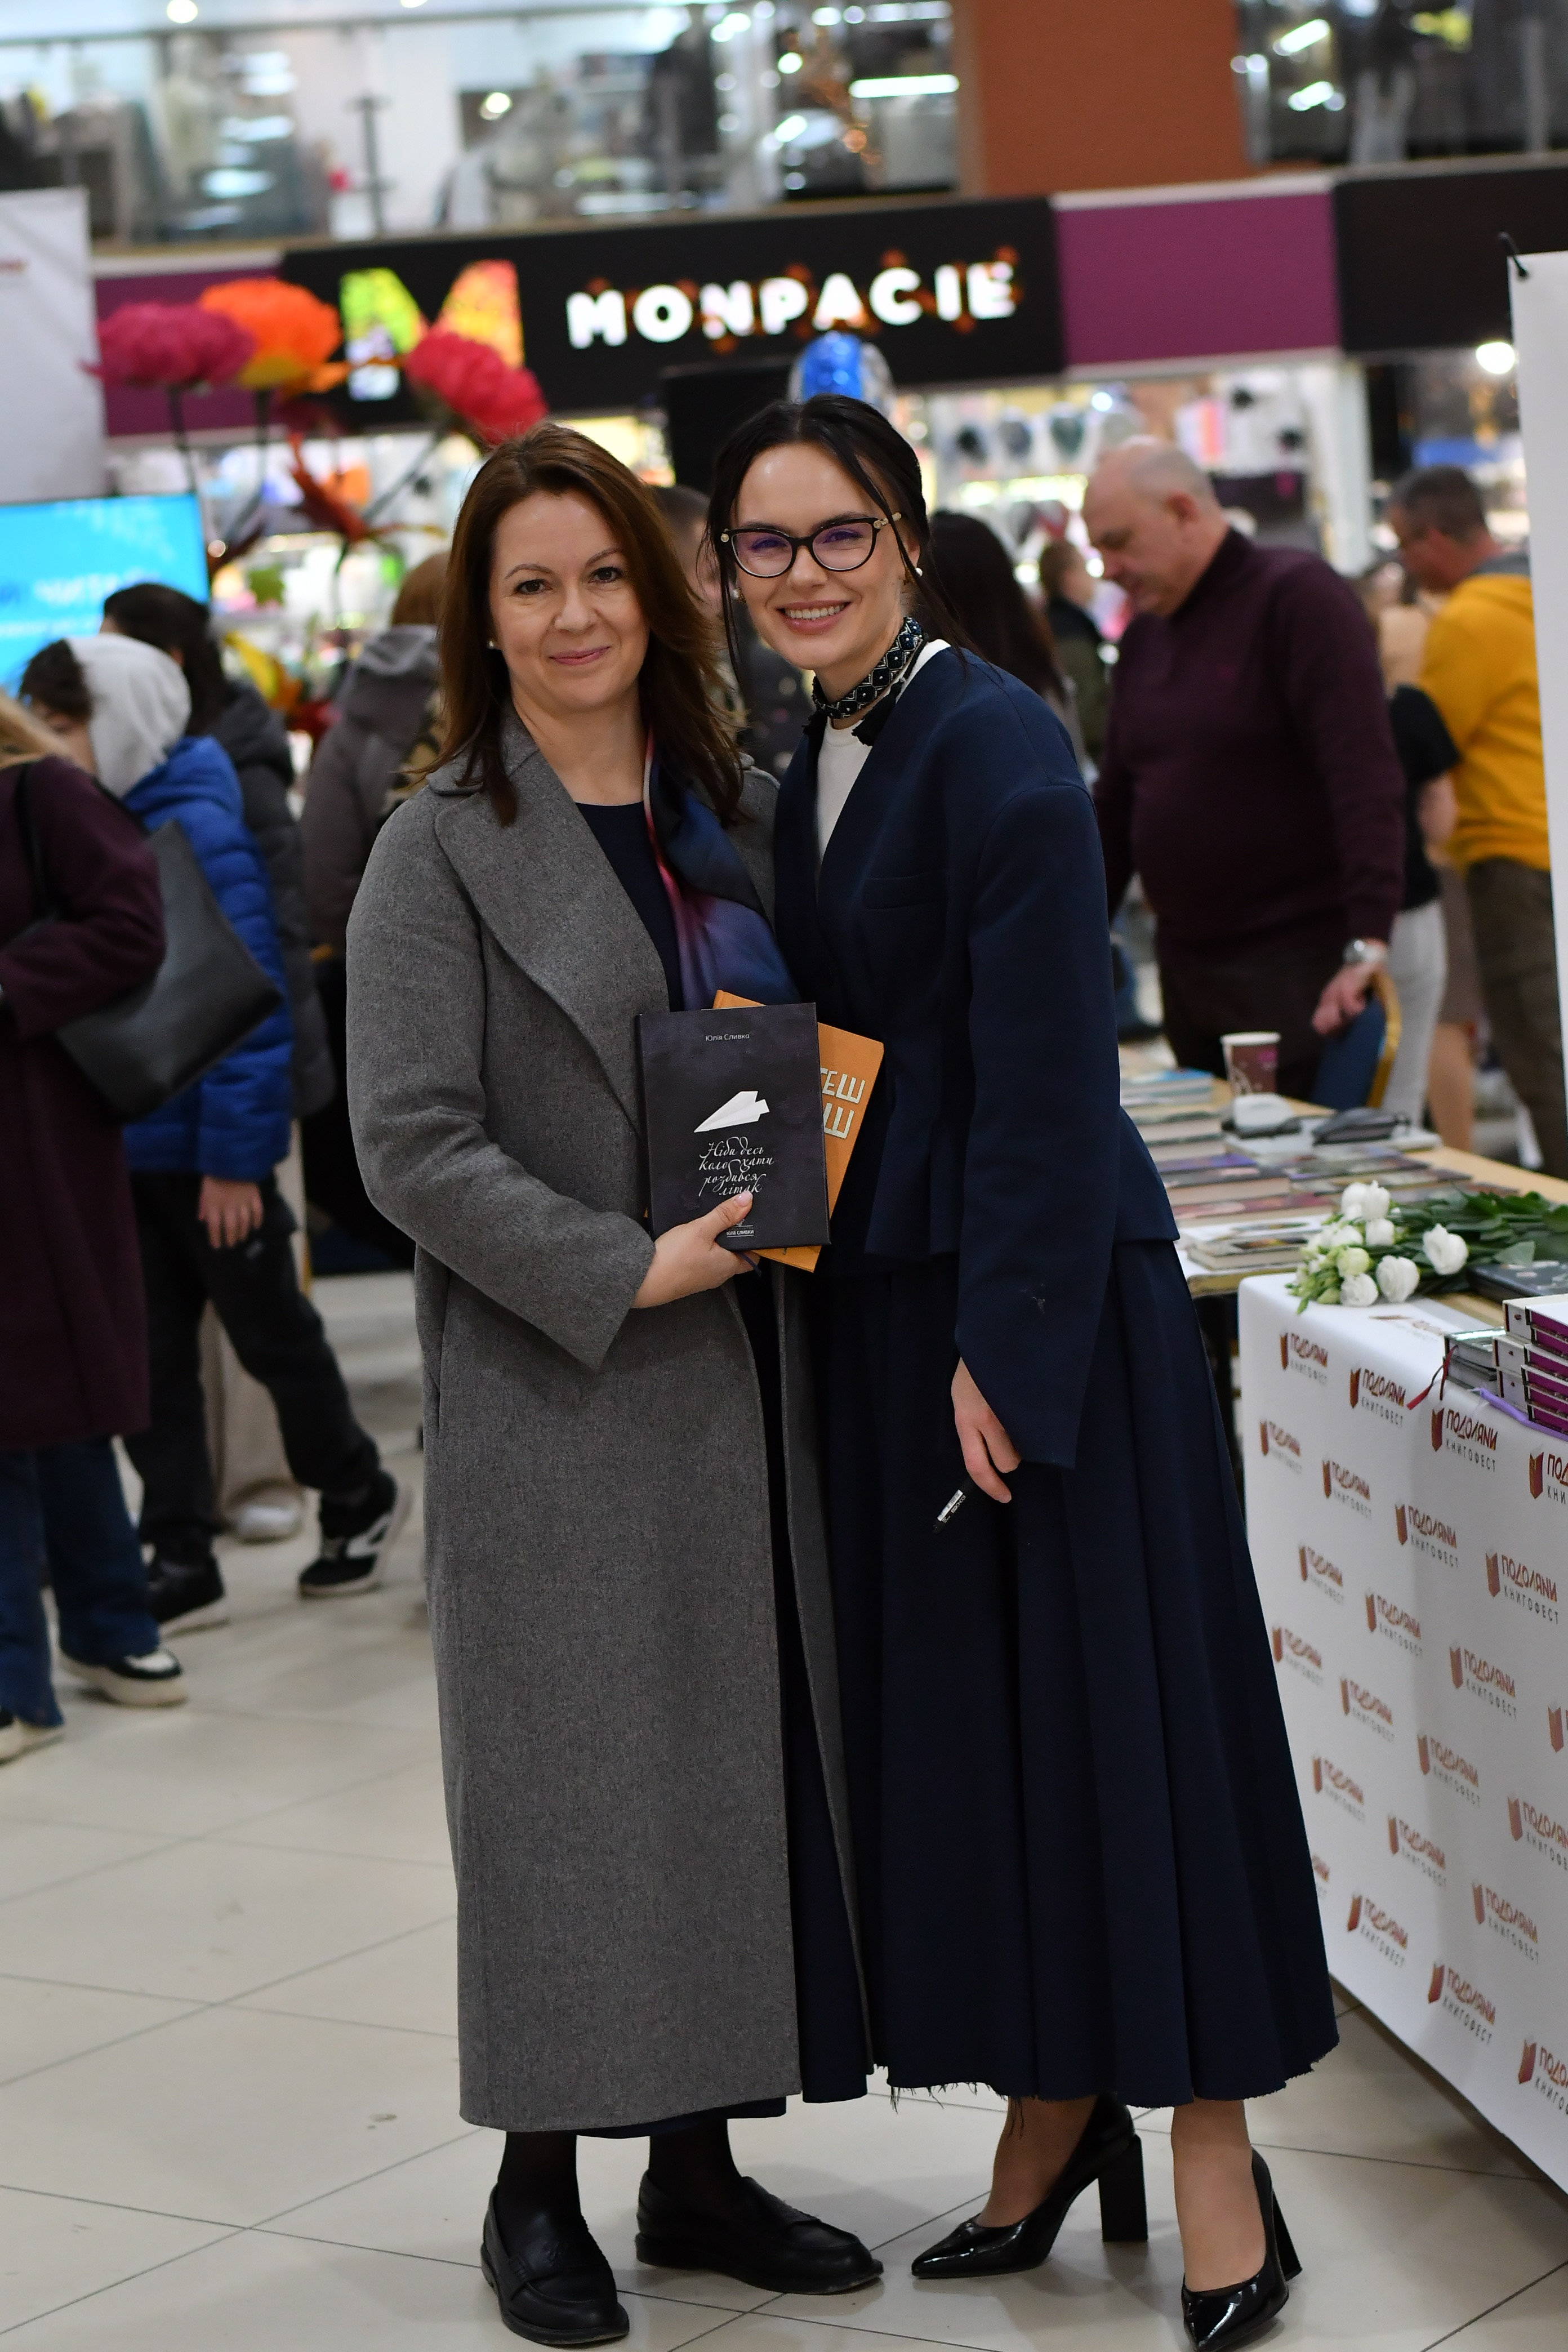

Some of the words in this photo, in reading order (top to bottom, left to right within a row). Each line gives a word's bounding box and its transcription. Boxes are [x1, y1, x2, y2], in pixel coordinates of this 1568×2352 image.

[565, 261, 1017, 349] MONPACIE
[700, 1137, 740, 1158] Ніби
[740, 1137, 764, 1156] десь
[741, 1157, 774, 1168] хати
[719, 1174, 766, 1195] літак
[1446, 1439, 1495, 1472] КНИГОФЕСТ
